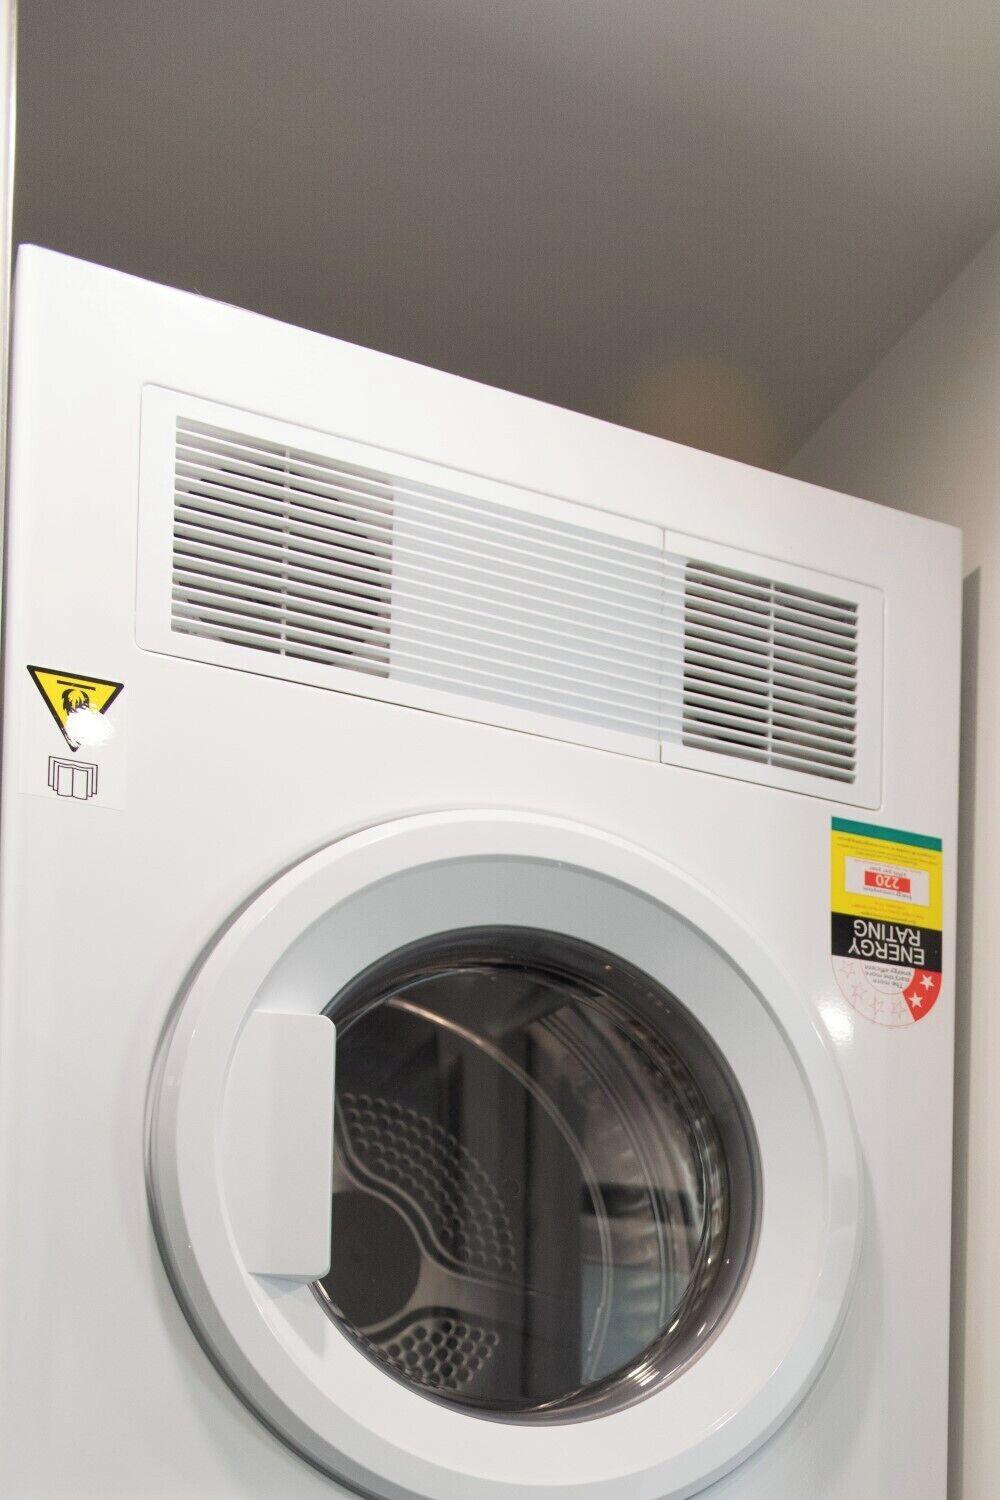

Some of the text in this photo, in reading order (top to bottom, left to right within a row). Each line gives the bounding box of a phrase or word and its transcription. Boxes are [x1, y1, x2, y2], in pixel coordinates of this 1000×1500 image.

[876, 874, 900, 890] 220
[853, 919, 921, 947] RATING
[848, 937, 925, 966] ENERGY
